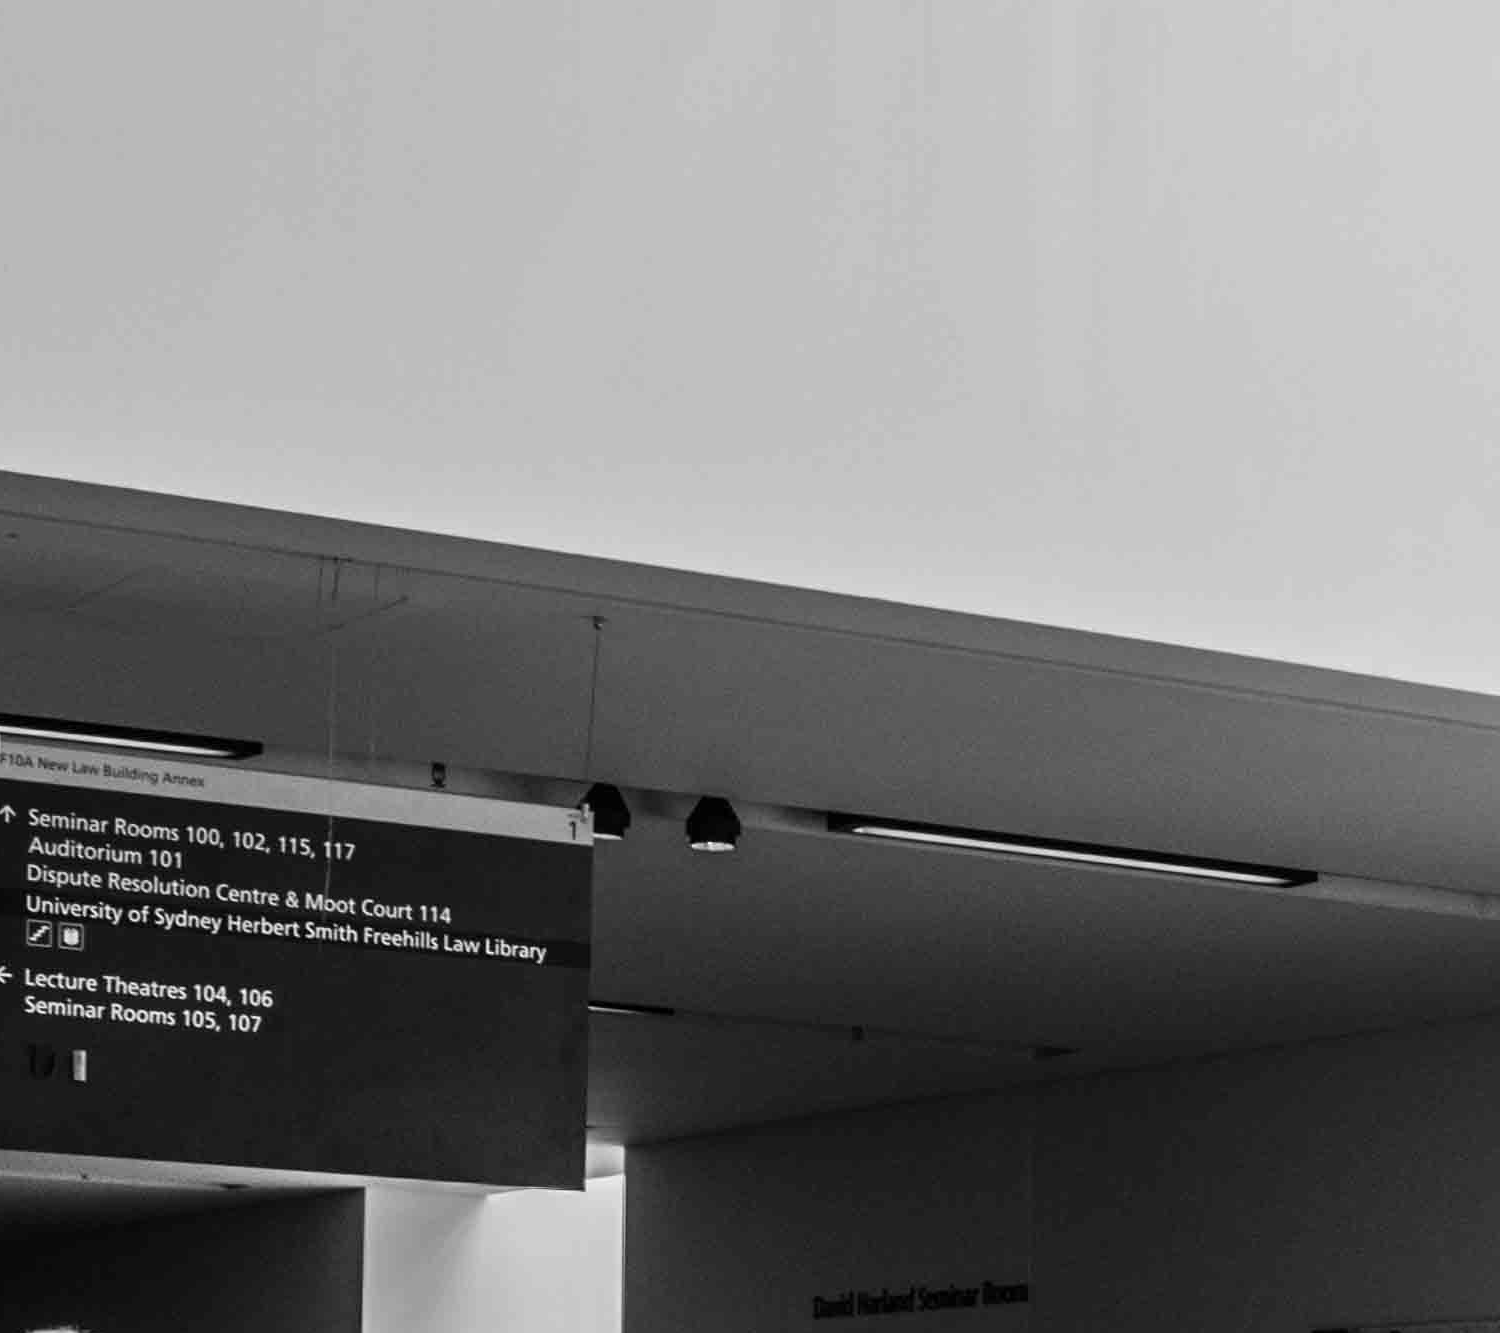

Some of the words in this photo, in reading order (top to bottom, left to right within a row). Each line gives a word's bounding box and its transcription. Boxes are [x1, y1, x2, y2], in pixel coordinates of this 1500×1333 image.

[0, 752, 33, 768] F10A
[38, 757, 68, 771] New
[72, 761, 100, 776] Law
[103, 763, 159, 785] Building
[162, 773, 205, 787] Annex
[28, 808, 109, 833] Seminar
[115, 818, 179, 842] Rooms
[186, 826, 224, 848] 100,
[233, 832, 270, 854] 102,
[278, 836, 315, 860] 115,
[323, 841, 355, 861] 117
[28, 836, 142, 864] Auditorium
[150, 849, 182, 868] 101
[27, 864, 102, 888] Dispute
[108, 872, 210, 899] Resolution
[216, 884, 280, 906] Centre
[285, 890, 300, 908] &
[305, 892, 356, 914] Moot
[361, 899, 412, 920] Court
[420, 905, 452, 924] 114
[26, 895, 123, 926] University
[128, 905, 150, 924] of
[154, 908, 222, 934] Sydney
[227, 915, 300, 938] Herbert
[305, 920, 358, 943] Smith
[363, 927, 438, 950] Freehills
[444, 934, 480, 953] Law
[485, 938, 547, 964] Library
[25, 968, 98, 993] Lecture
[102, 975, 188, 999] Theatres
[194, 984, 232, 1006] 104,
[240, 988, 273, 1007] 106
[24, 995, 106, 1019] Seminar
[111, 1003, 176, 1027] Rooms
[183, 1010, 221, 1032] 105,
[228, 1014, 262, 1033] 107
